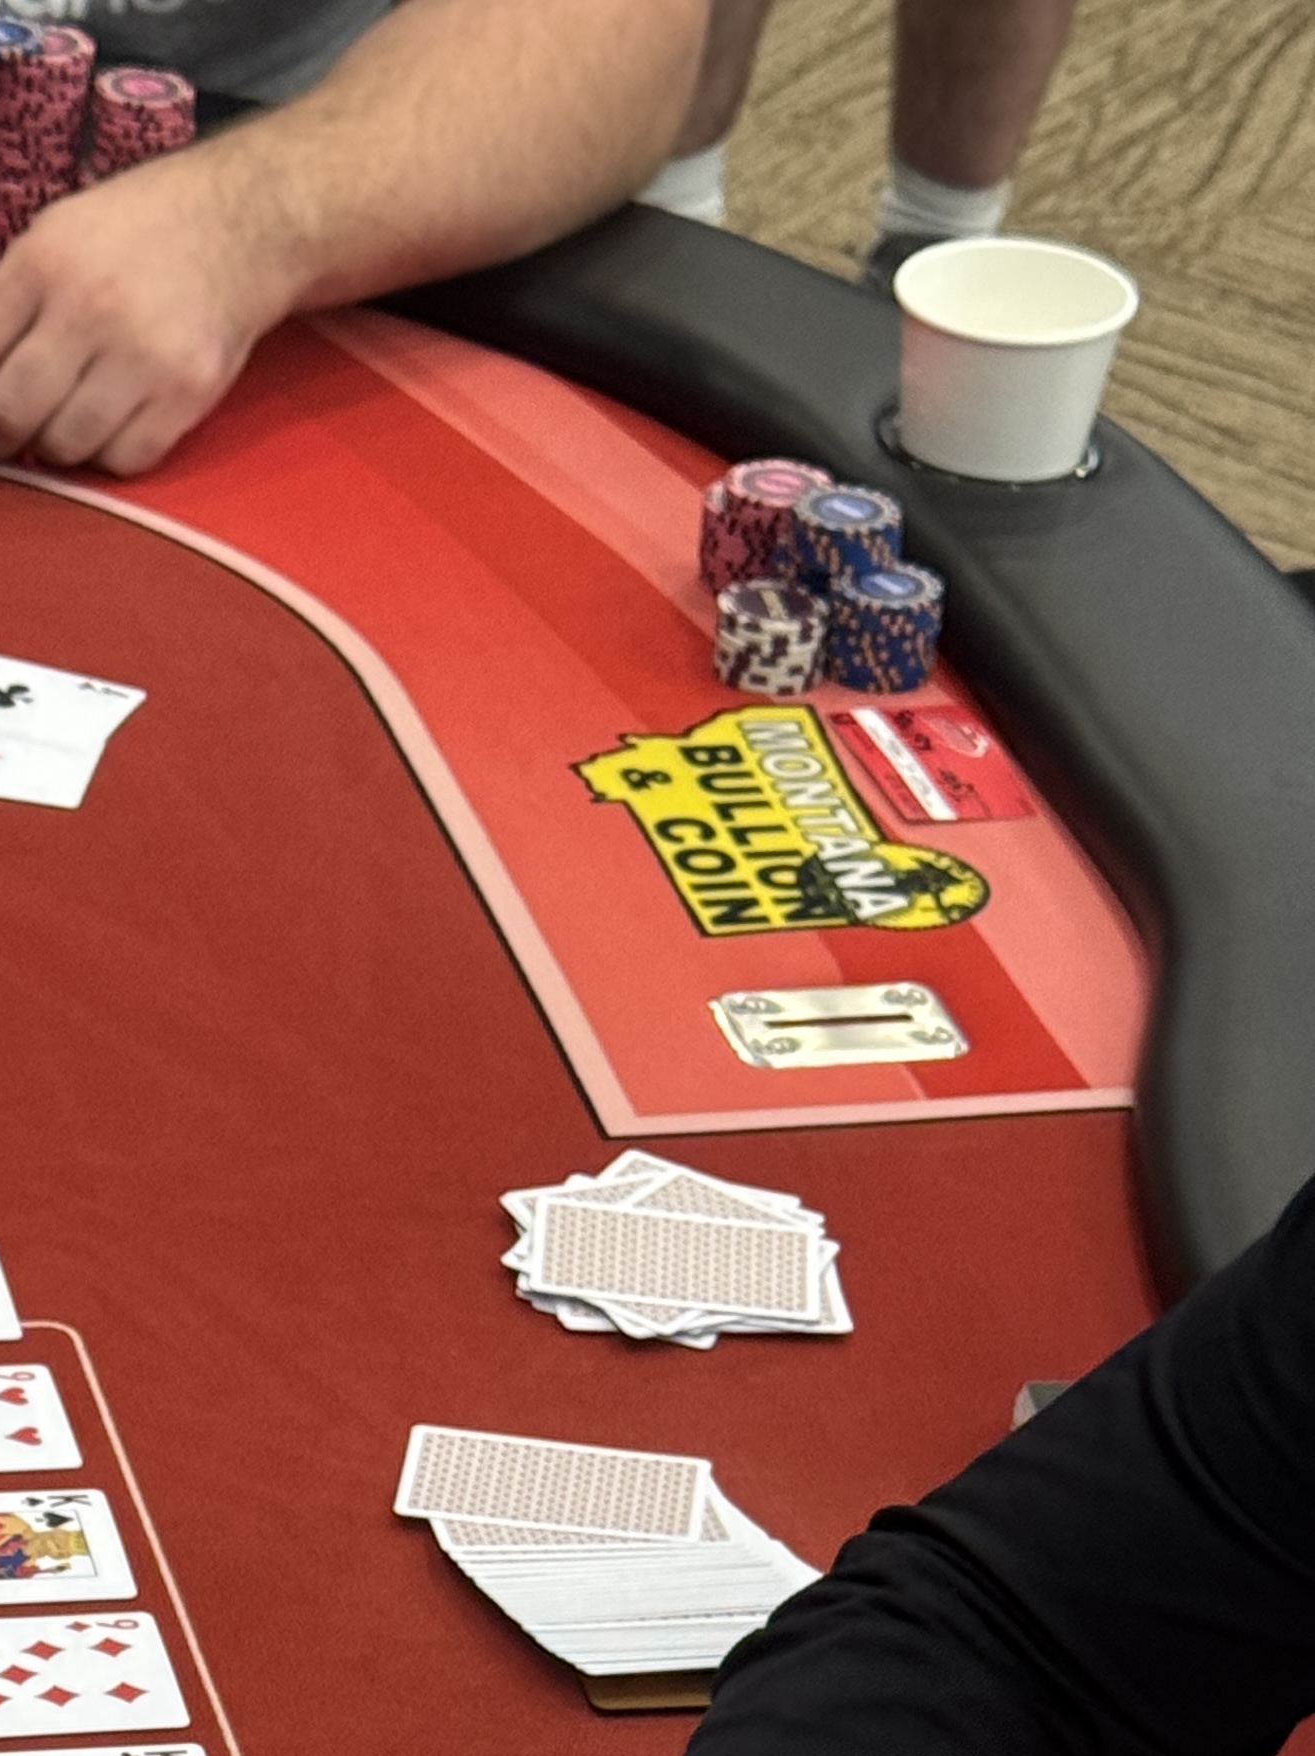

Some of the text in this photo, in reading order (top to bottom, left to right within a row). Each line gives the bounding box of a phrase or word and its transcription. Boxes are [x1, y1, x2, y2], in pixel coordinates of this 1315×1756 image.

[621, 767, 771, 926] & COIN
[682, 744, 844, 921] BULLION
[740, 720, 910, 920] MONTANA
[48, 1494, 93, 1507] K
[95, 1619, 140, 1630] 9
